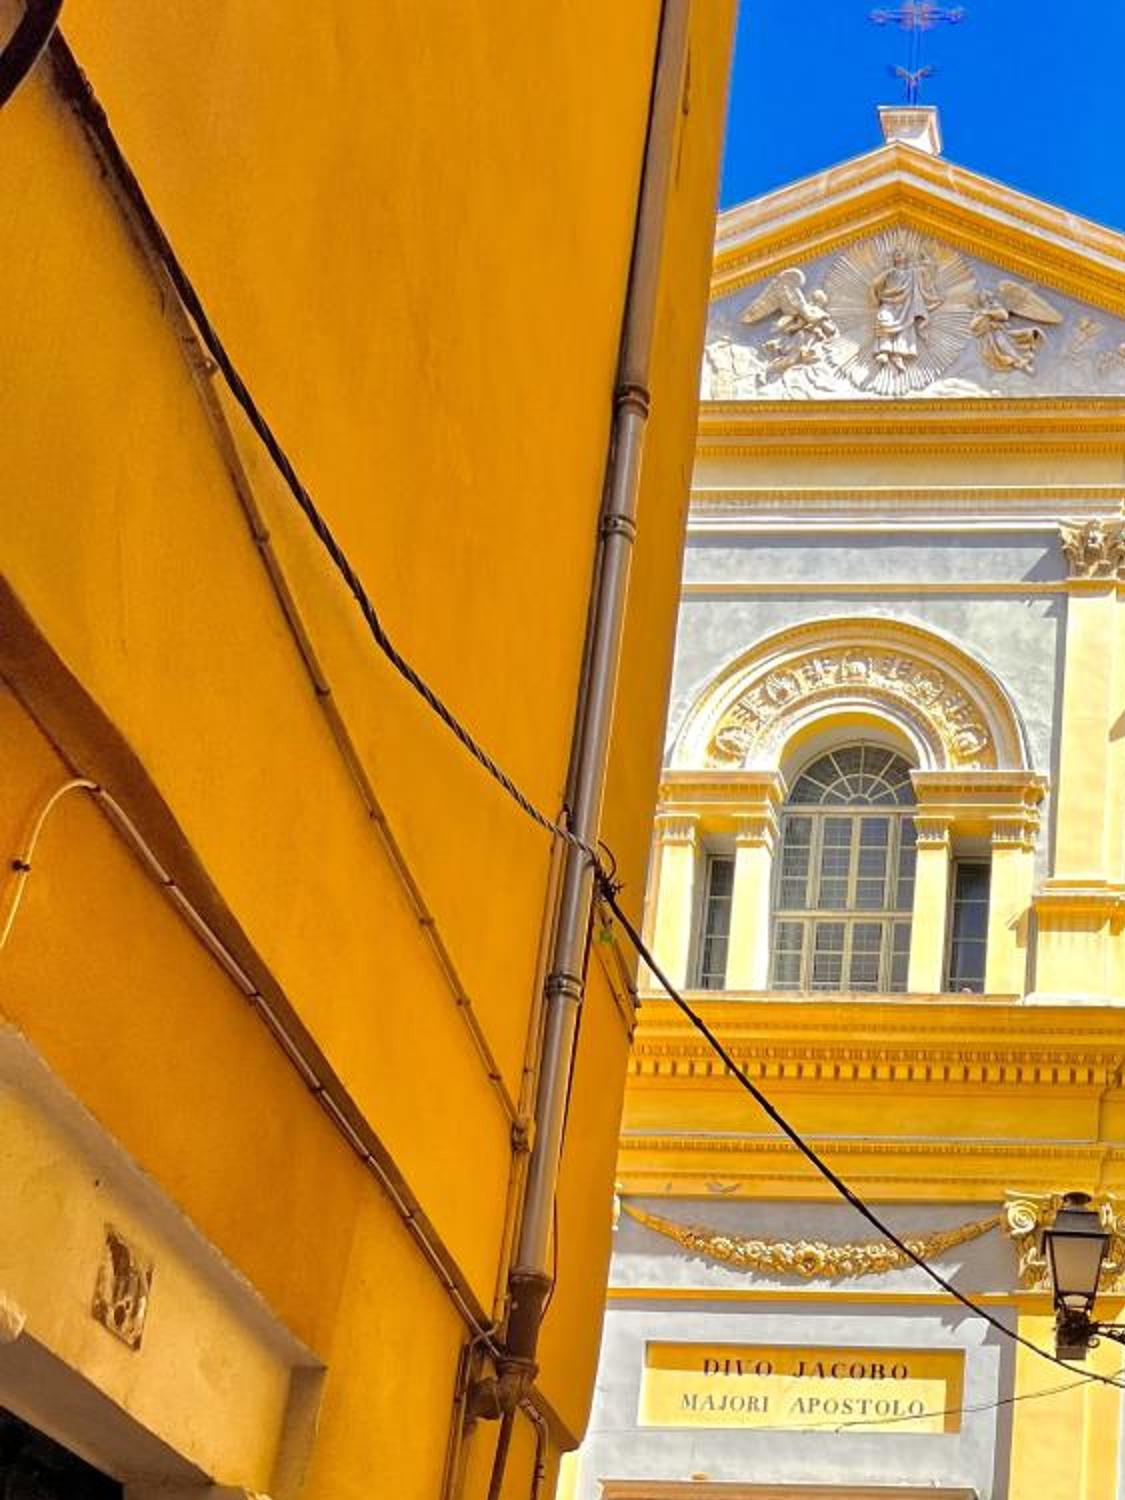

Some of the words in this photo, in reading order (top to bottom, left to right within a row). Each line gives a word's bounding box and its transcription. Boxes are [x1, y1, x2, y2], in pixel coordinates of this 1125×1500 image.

[702, 1357, 774, 1377] DIVO
[791, 1360, 910, 1381] JACOBO
[680, 1393, 769, 1413] MAJORI
[788, 1396, 926, 1416] APOSTOLO
